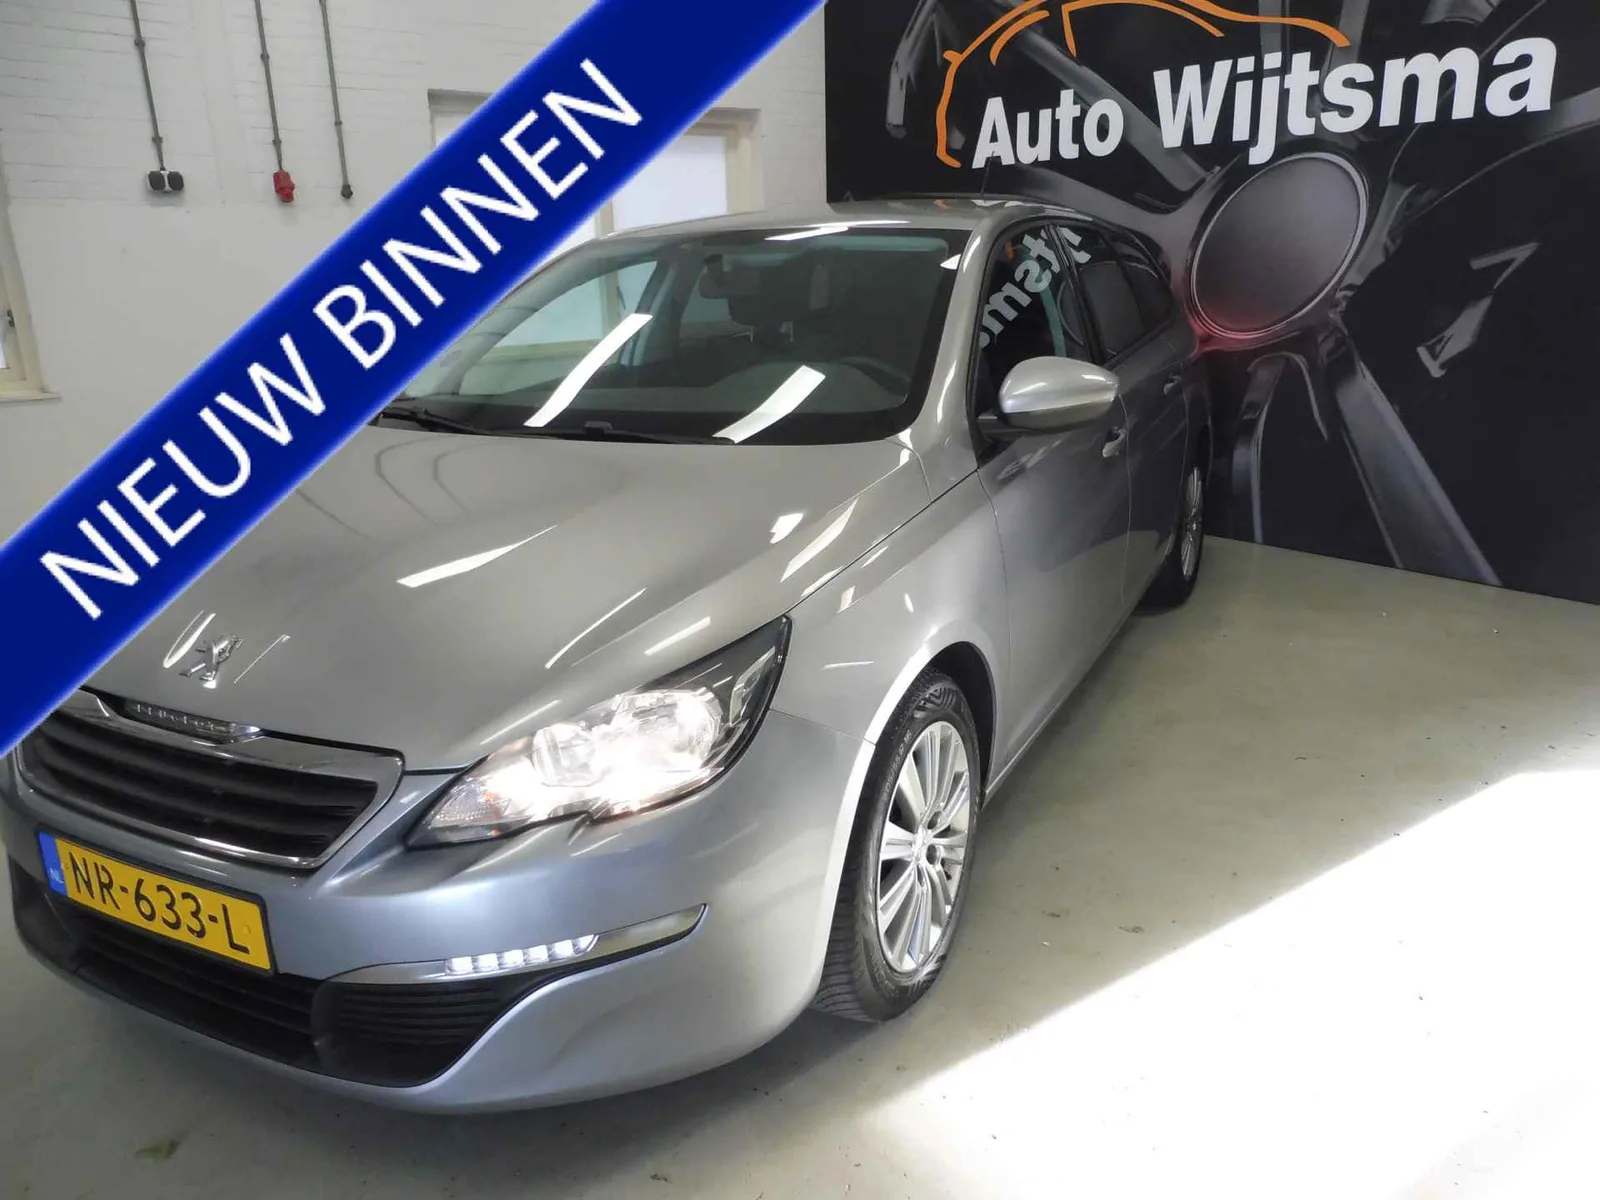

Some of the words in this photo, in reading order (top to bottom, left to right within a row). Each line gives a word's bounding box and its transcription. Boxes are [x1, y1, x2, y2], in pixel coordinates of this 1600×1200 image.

[972, 89, 1124, 168] Auto
[1153, 38, 1557, 165] Wijtsma
[69, 851, 250, 955] NR-633-L
